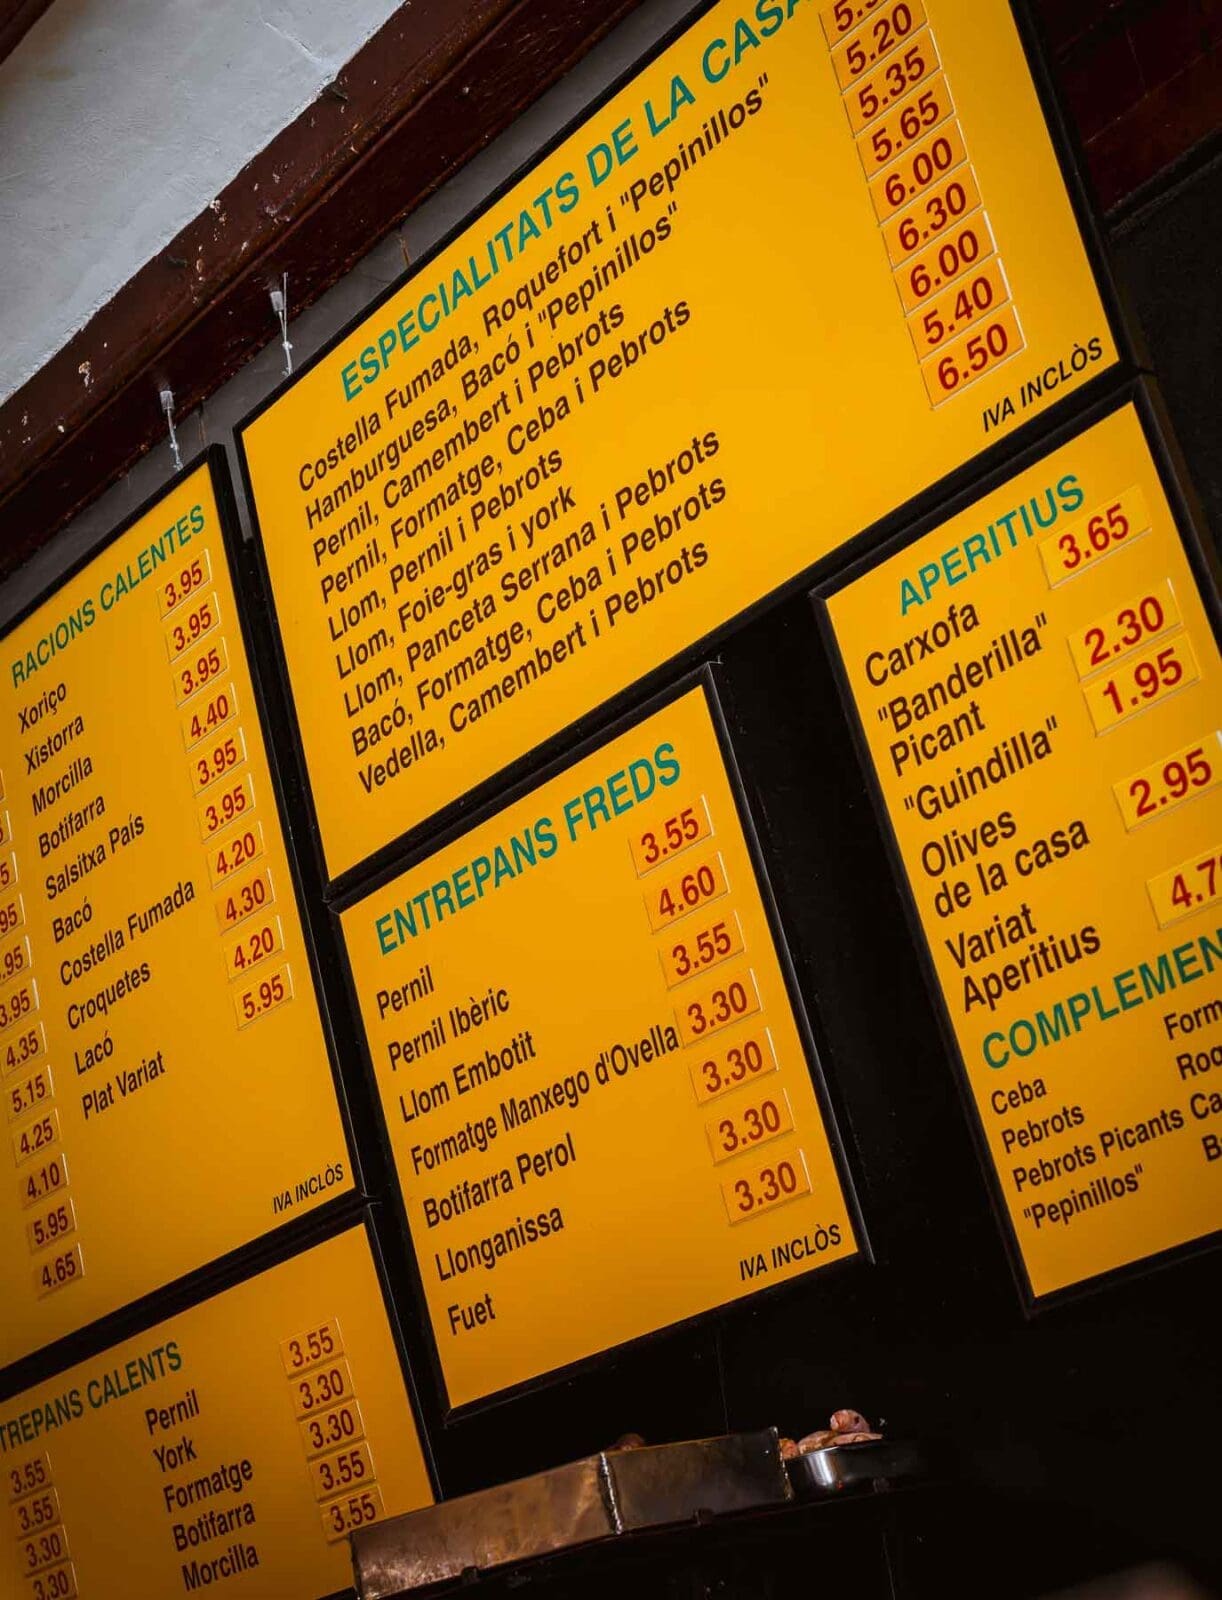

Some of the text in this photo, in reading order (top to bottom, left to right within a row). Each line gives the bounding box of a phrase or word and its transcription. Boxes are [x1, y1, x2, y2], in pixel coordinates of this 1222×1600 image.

[846, 2, 912, 75] 5.20
[858, 45, 925, 119] 5.35
[871, 90, 940, 163] 5.65
[341, 0, 800, 402] ESPECIALITATS DE LA CAS
[885, 137, 953, 207] 6.00
[898, 182, 967, 251] 6.30
[299, 72, 769, 492] Costella Fumada, Roquefort i "Pepinillos"
[910, 229, 979, 298] 6.00
[923, 276, 993, 345] 5.40
[305, 200, 678, 530] Hamburguesa, Bacó i "Pepinillos"
[937, 323, 1008, 391] 6.50
[982, 337, 1102, 433] IVA INCLÒS
[312, 304, 625, 567] Pernil, Camembert i Pebrots
[320, 301, 691, 605] Pernil, Formatge, Ceba i Pebrots
[328, 449, 563, 642] Llom, Pernil i Pebrots
[901, 474, 1084, 617] APERITIUS
[1058, 503, 1129, 569] 3.65
[11, 506, 204, 689] RACIONS CALENTES
[164, 559, 203, 608] 3.95
[335, 485, 577, 680] Llom, Foie-gras i york
[343, 431, 720, 718] Llom, Panceta Serrana i Pebrots
[173, 603, 212, 652] 3.95
[351, 478, 726, 757] Bacó, Formatge, Ceba i Pebrots
[865, 604, 980, 687] Carxofa
[1084, 596, 1164, 666] 2.30
[181, 647, 220, 695] 3.95
[358, 542, 708, 794] Vedella, Camembert i Pebrots
[877, 612, 1047, 733] "Banderilla"
[1103, 647, 1183, 714] 1.95
[17, 683, 67, 734] Xoriço
[191, 694, 229, 738] 4.40
[889, 700, 986, 778] Picant
[24, 715, 84, 775] Xistorra
[197, 738, 237, 785] 3.95
[903, 715, 1058, 820] "Guindilla"
[31, 756, 93, 817] Morcilla
[205, 784, 246, 832] 3.95
[1129, 747, 1212, 818] 2.95
[38, 795, 106, 858] Botifarra
[216, 832, 256, 874] 4.20
[375, 742, 681, 956] ENTREPANS FREDS
[641, 807, 699, 864] 3.55
[921, 811, 1017, 877] Olives
[45, 844, 107, 900] Salsitxa
[108, 815, 145, 854] País
[934, 820, 1090, 918] de la casa
[1171, 855, 1222, 908] 4.7
[52, 896, 93, 944] Bacó
[226, 878, 265, 921] 4.30
[659, 865, 715, 917] 4.60
[60, 881, 195, 986] Costella Fumada
[234, 927, 274, 969] 4.20
[672, 922, 731, 977] 3.55
[944, 903, 1037, 969] Variat
[67, 962, 151, 1030] Croquetes
[242, 974, 284, 1019] 5.95
[376, 964, 435, 1020] Pernil
[963, 925, 1101, 1014] Aperitius
[387, 989, 510, 1071] Pernil Ibèric
[687, 982, 747, 1035] 3.30
[6, 1030, 39, 1067] 4.35
[74, 1030, 114, 1076] Lacó
[399, 1030, 536, 1123] Llom Embotit
[702, 1040, 763, 1093] 3.30
[12, 1074, 46, 1113] 5.15
[81, 1050, 166, 1120] Plat Variat
[410, 1024, 680, 1176] Formatge Manxego d'Ovella
[991, 1078, 1047, 1115] Ceba
[20, 1117, 53, 1154] 4.25
[719, 1100, 781, 1152] 3.30
[1001, 1106, 1085, 1154] Pebrots
[1012, 1145, 1097, 1193] Pebrots
[1098, 1109, 1185, 1158] Picants
[27, 1162, 60, 1199] 4.10
[273, 1163, 342, 1214] IVA INCLÒS
[422, 1132, 576, 1228] Botifarra Perol
[734, 1161, 797, 1212] 3.30
[1023, 1163, 1143, 1229] "Pepinillos"
[33, 1205, 69, 1245] 5.95
[434, 1207, 565, 1282] Llonganissa
[739, 1224, 841, 1281] IVA INCLÒS
[42, 1251, 76, 1288] 4.65
[447, 1293, 496, 1336] Fuet
[87, 1342, 182, 1409] CALENTS
[289, 1326, 334, 1368] 3.55
[144, 1388, 200, 1436] Pernil
[299, 1369, 344, 1410] 3.30
[152, 1435, 198, 1473] York
[309, 1409, 355, 1449] 3.30
[10, 1458, 46, 1494] 3.55
[163, 1459, 253, 1513] Formatge
[319, 1450, 365, 1491] 3.55
[17, 1495, 54, 1531] 3.55
[172, 1502, 256, 1552] Botifarra
[330, 1493, 376, 1533] 3.55
[25, 1532, 62, 1568] 3.30
[181, 1543, 260, 1592] Morcilla
